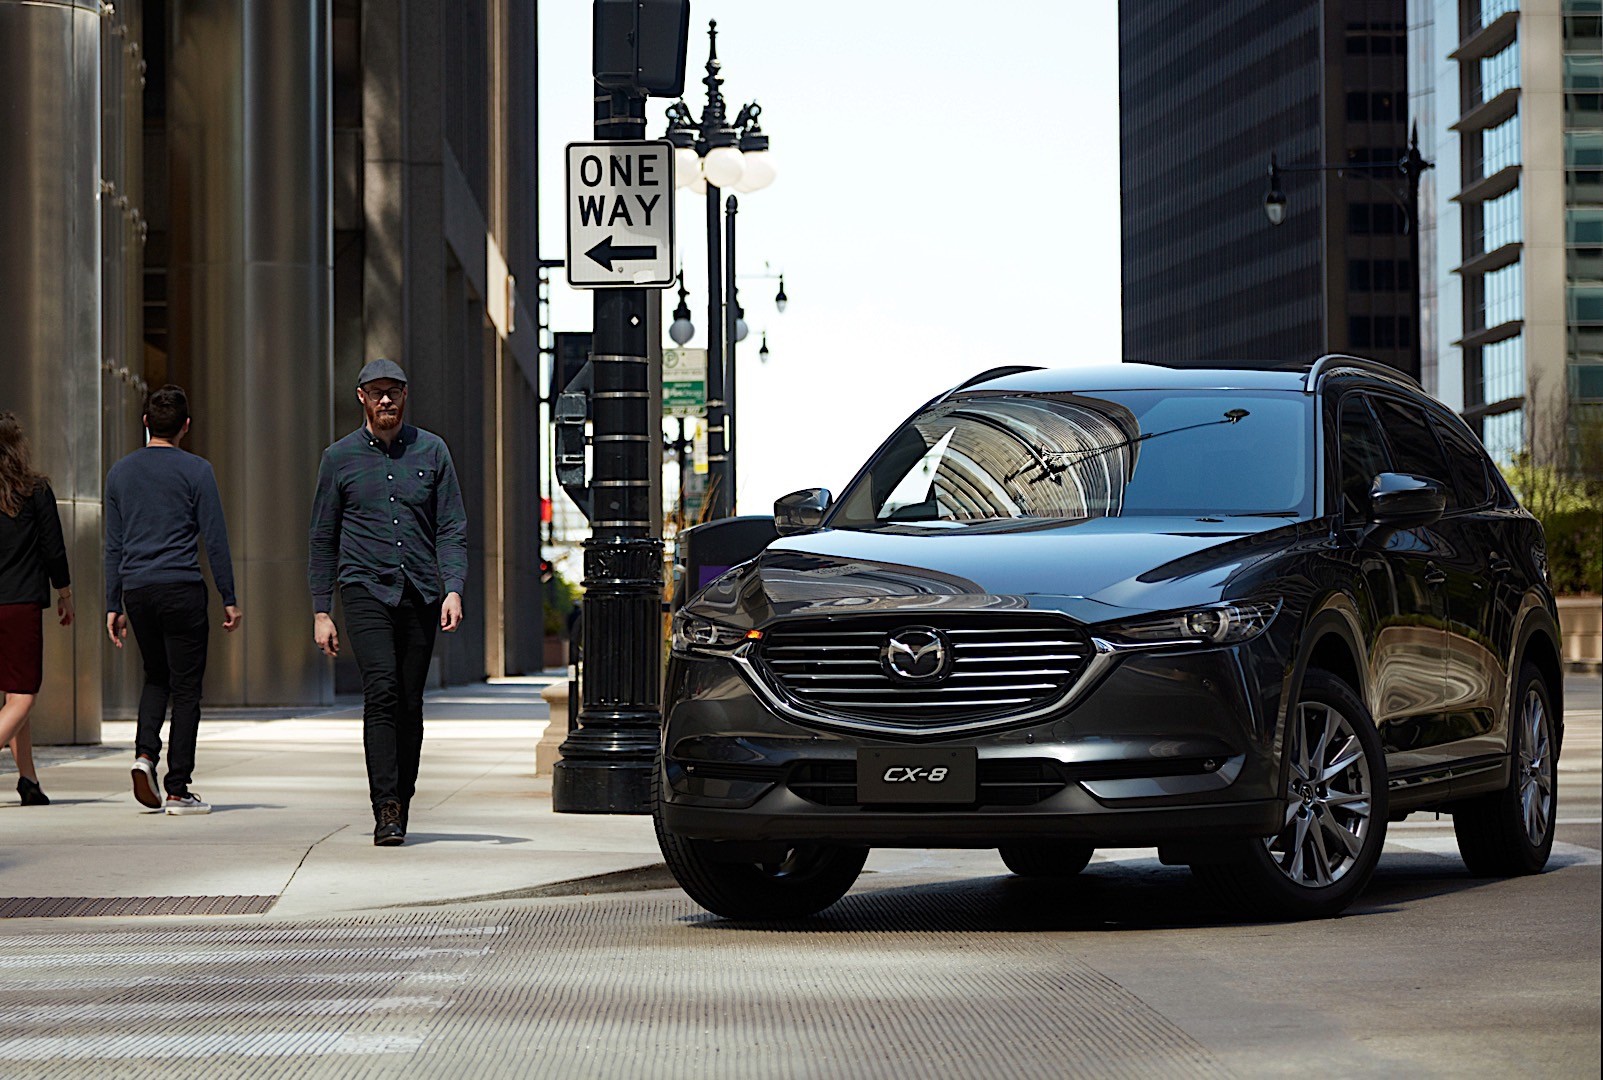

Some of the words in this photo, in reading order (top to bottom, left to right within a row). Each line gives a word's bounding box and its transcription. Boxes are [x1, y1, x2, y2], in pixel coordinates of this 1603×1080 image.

[580, 154, 659, 187] ONE
[578, 194, 660, 226] WAY
[883, 767, 948, 782] CX-8
